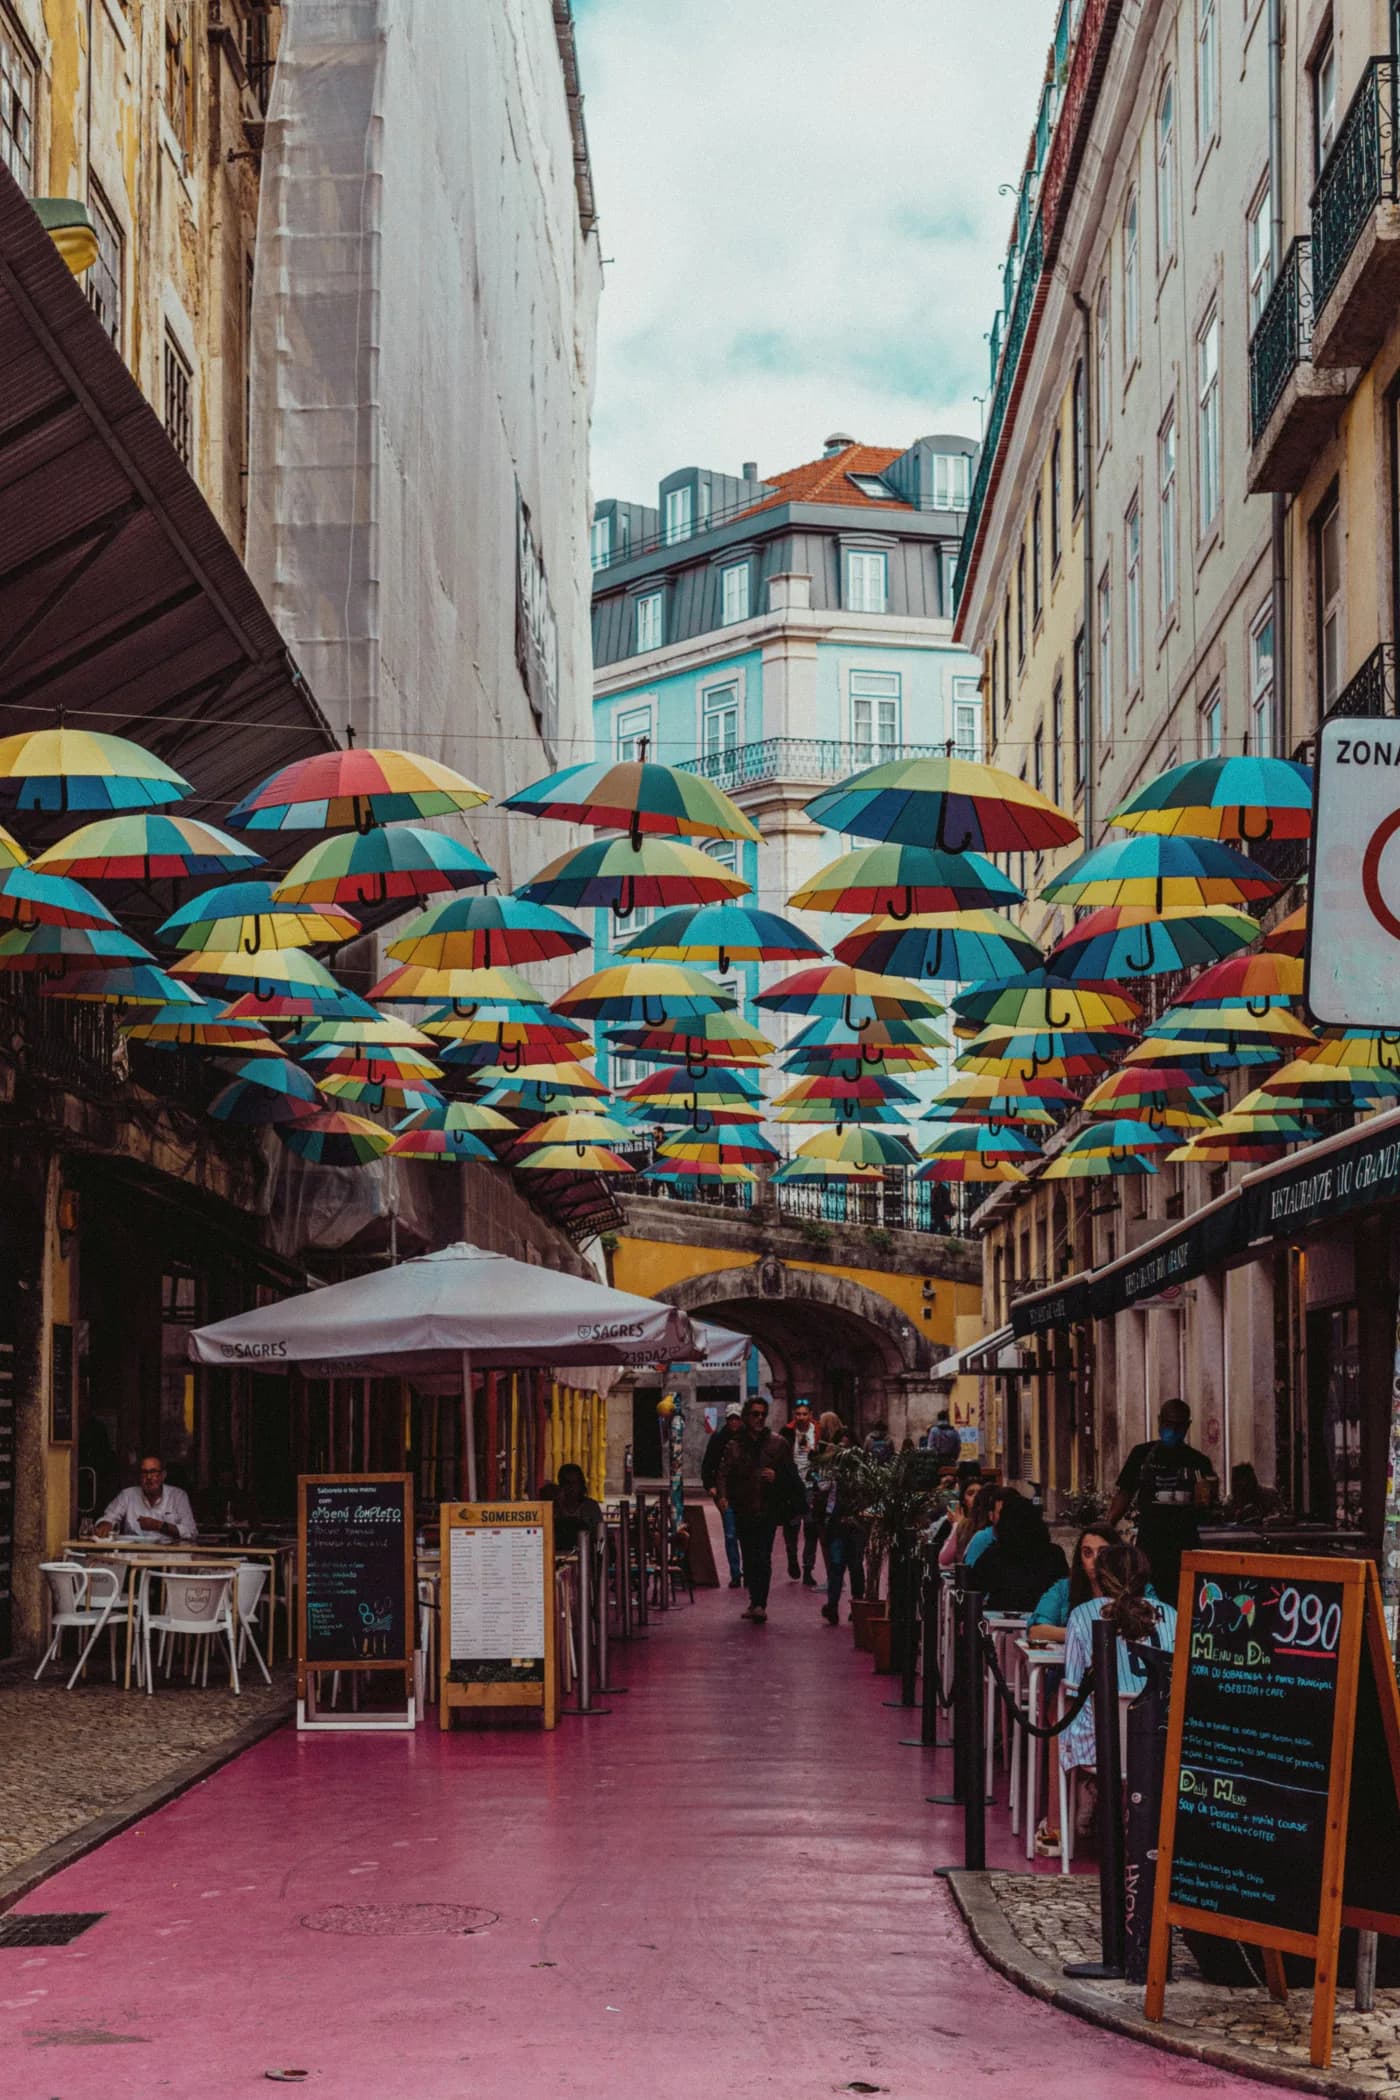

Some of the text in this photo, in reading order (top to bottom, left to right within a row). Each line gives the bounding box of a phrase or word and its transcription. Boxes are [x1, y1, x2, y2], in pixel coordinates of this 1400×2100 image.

[592, 1322, 645, 1340] SAGRES
[234, 1341, 288, 1359] SAGRES
[481, 1510, 538, 1522] SOMERSBY
